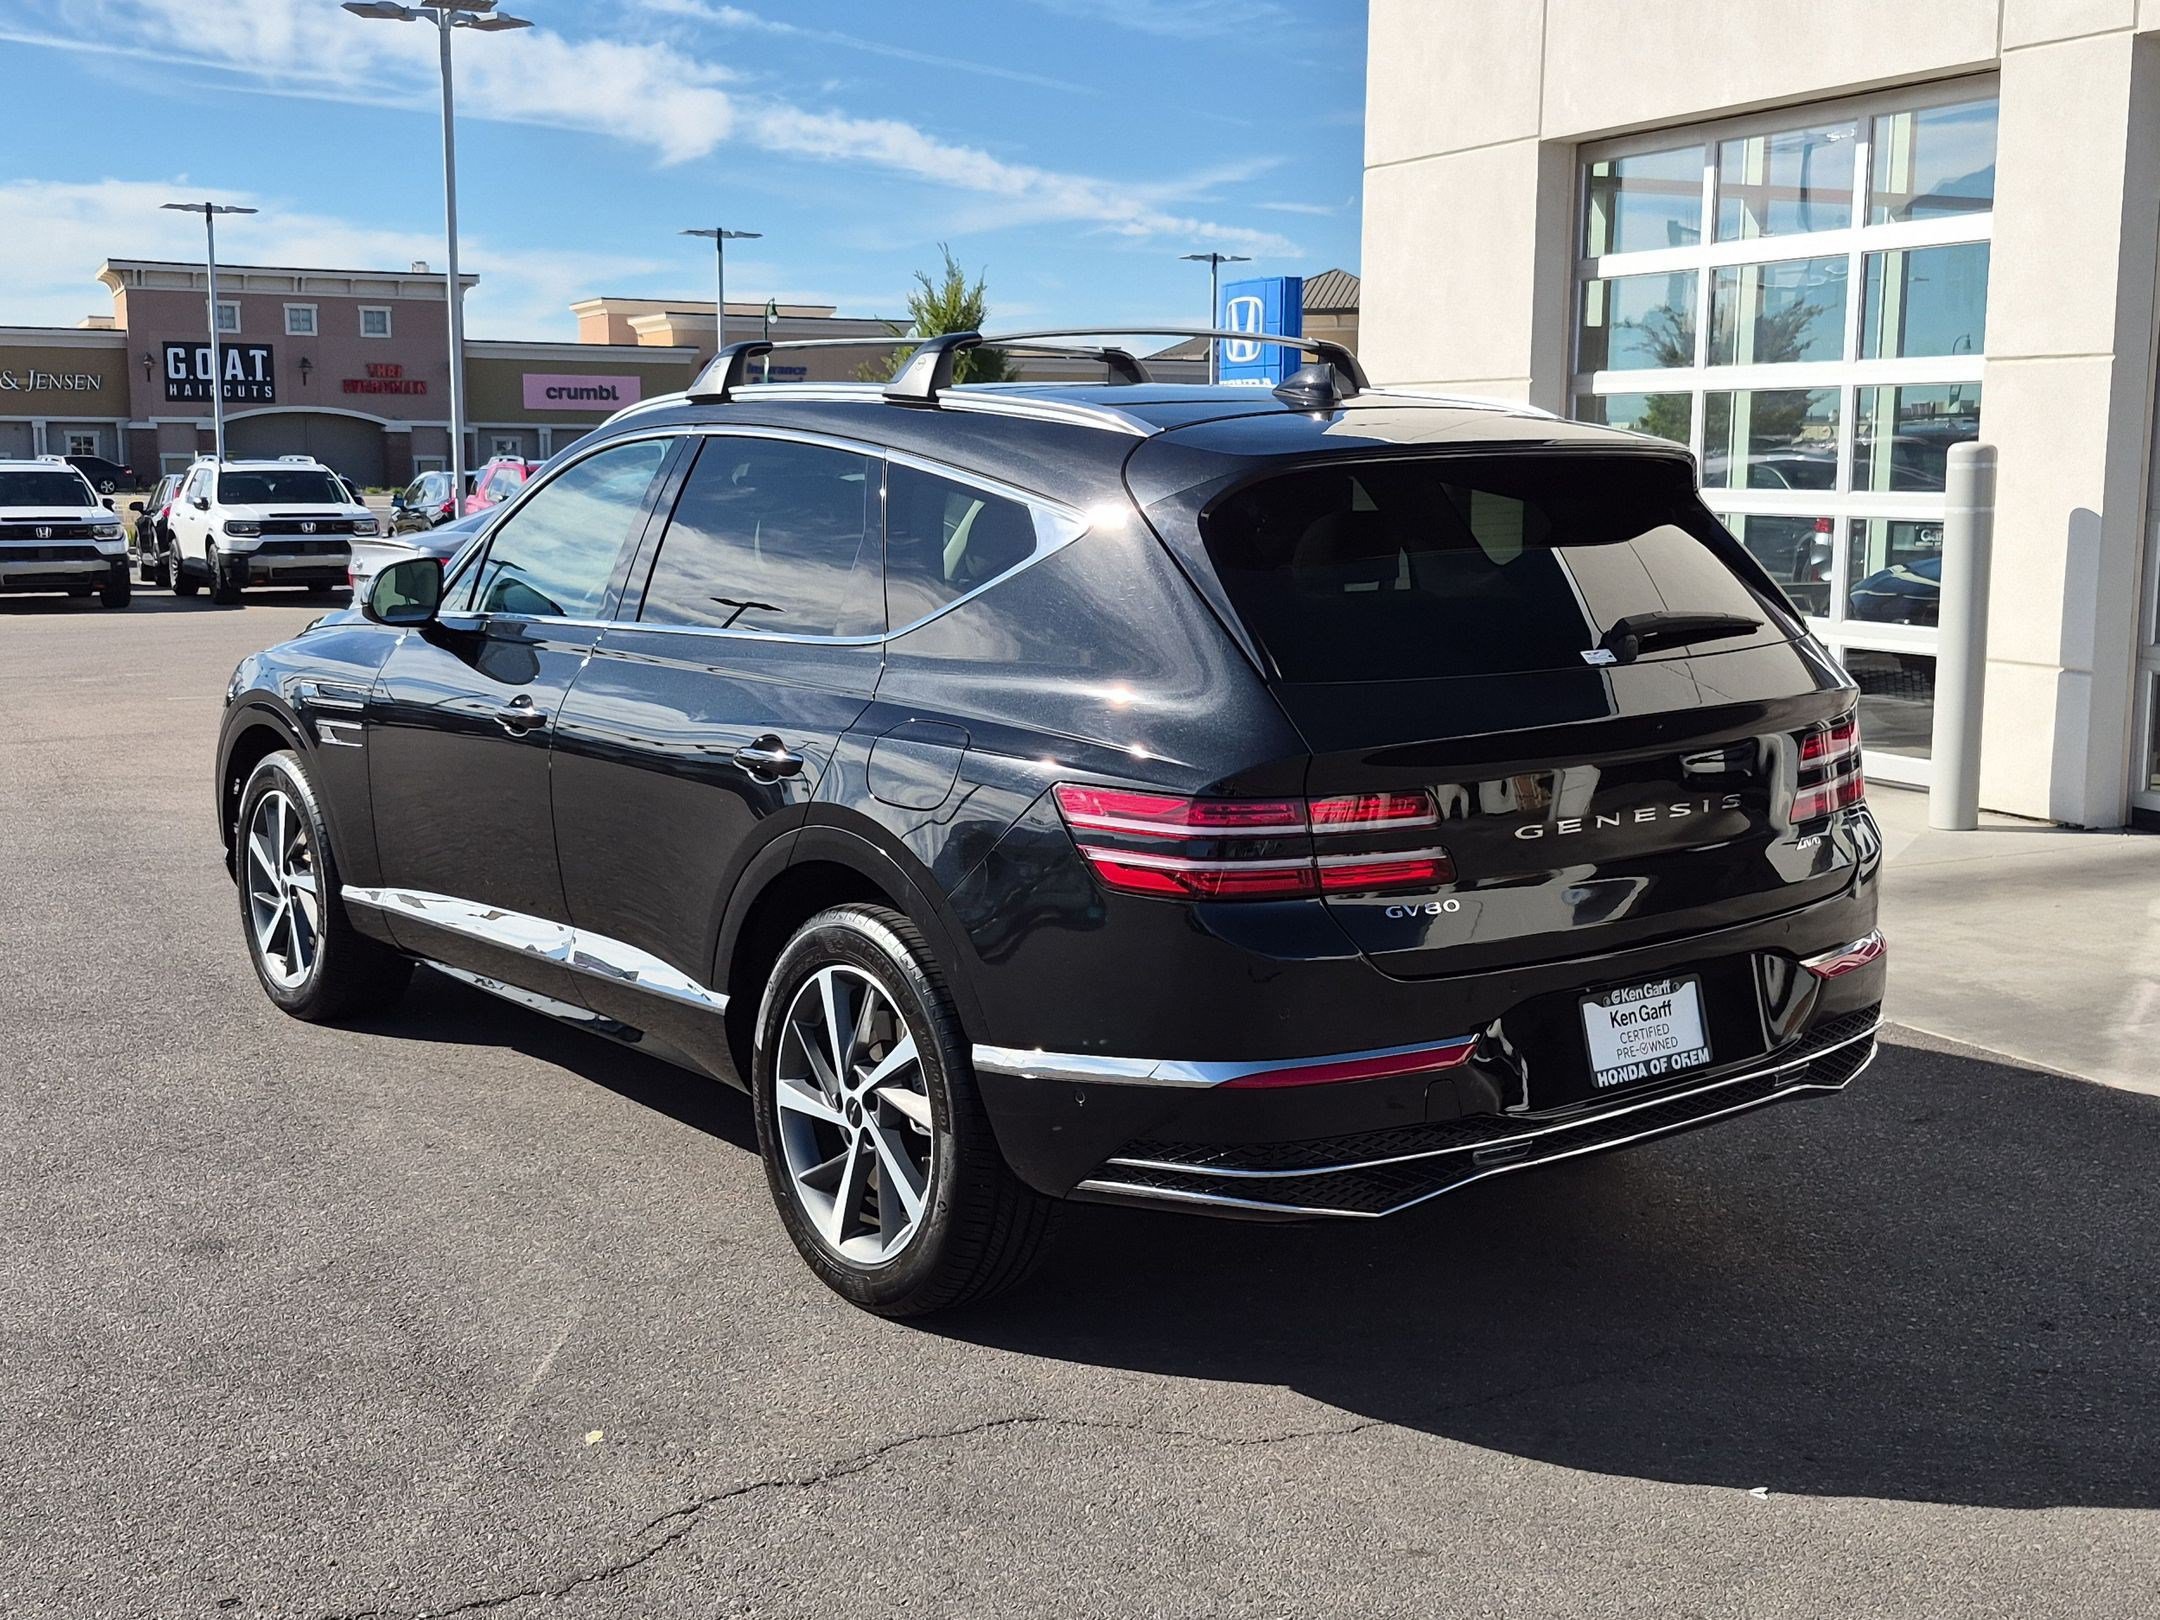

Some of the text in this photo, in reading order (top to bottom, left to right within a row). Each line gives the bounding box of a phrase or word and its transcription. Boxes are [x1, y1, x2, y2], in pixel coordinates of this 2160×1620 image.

[166, 347, 271, 381] G.OA.T.
[0, 369, 21, 390] &
[545, 384, 620, 401] crumbl
[1514, 793, 1743, 840] GENESIS
[1385, 898, 1460, 919] GV80
[1621, 979, 1672, 1003] Ken Garff
[1610, 1000, 1673, 1029] Ken Garff
[1619, 1023, 1670, 1044] CERTIFIED
[1616, 1036, 1679, 1061] PRE-OWNED
[1596, 1048, 1710, 1088] HONDA OF OREM
